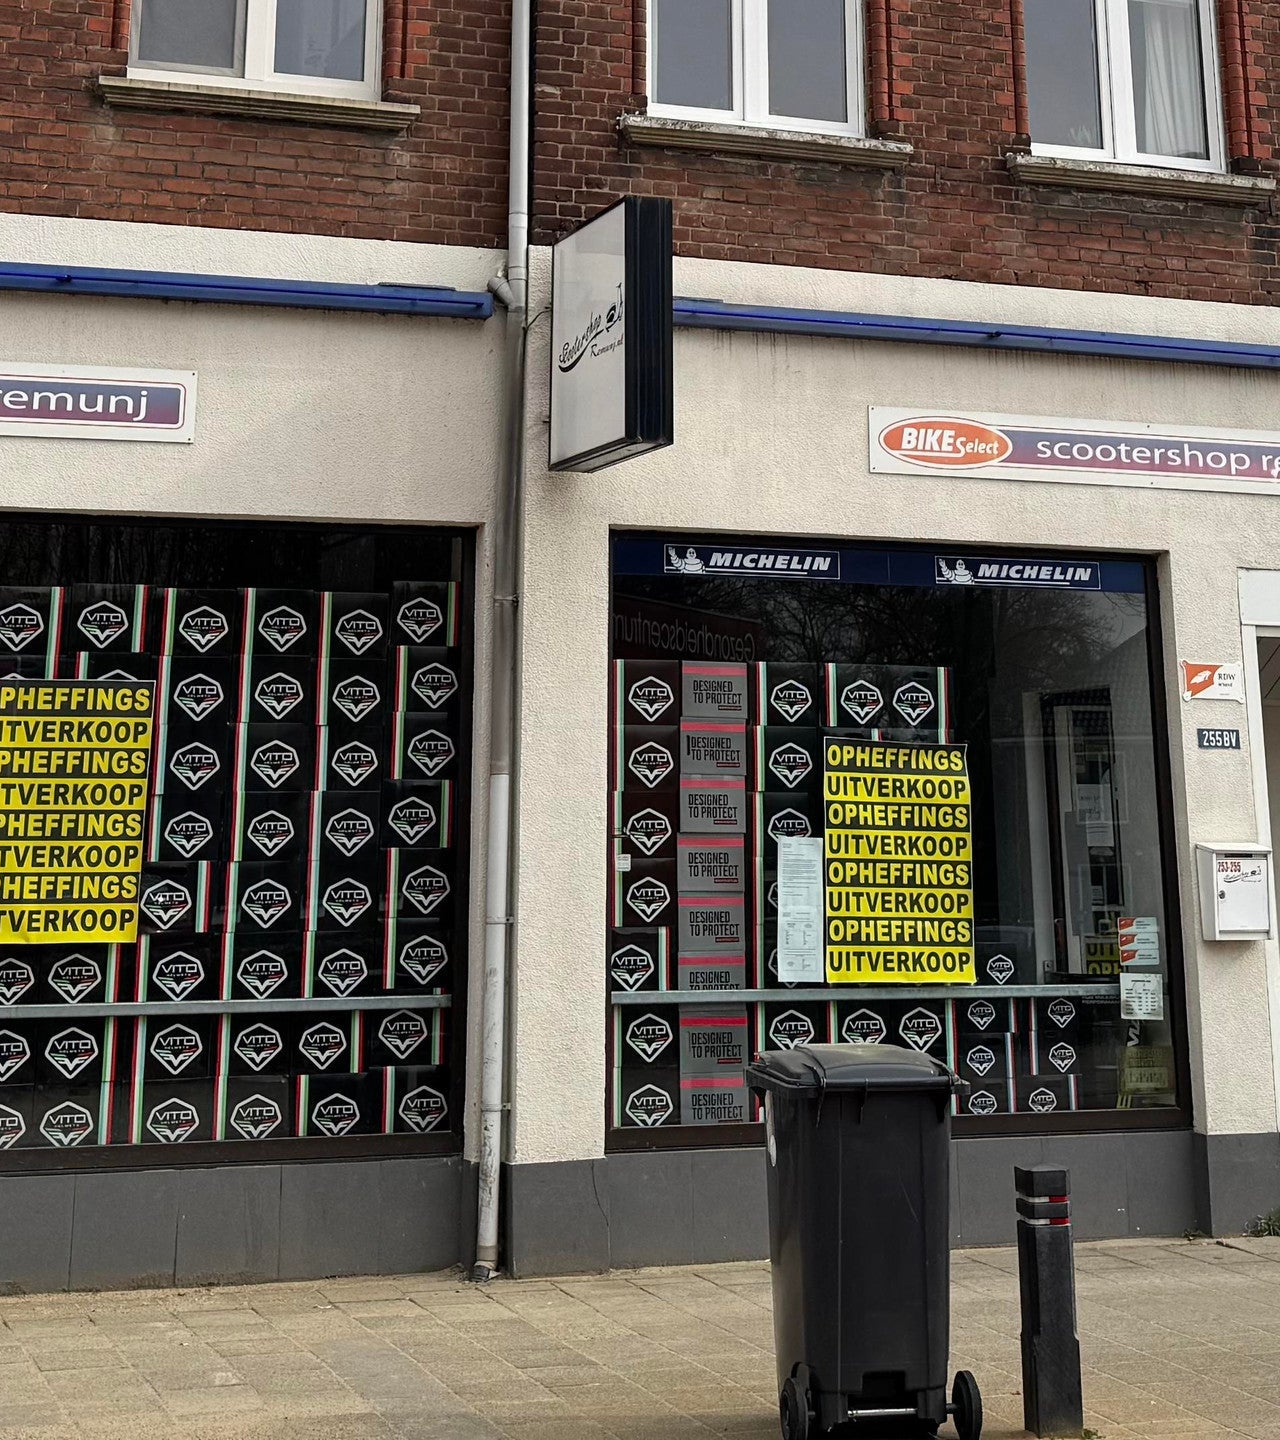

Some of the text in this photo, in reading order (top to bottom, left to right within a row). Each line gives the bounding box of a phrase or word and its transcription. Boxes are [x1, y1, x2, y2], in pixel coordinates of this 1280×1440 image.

[901, 428, 955, 452] BIKE
[955, 437, 999, 457] Select
[1037, 441, 1250, 474] scootershop
[709, 552, 831, 571] MICHELIN
[978, 564, 1091, 581] MICHELIN
[87, 612, 121, 621] VITO
[404, 609, 436, 617] VITO
[2, 615, 36, 624] VITO
[187, 617, 220, 626] VITO
[266, 617, 299, 626] VITO
[343, 621, 375, 629] VITO
[419, 674, 451, 682] VITO
[182, 685, 216, 694] VITO
[262, 684, 295, 693] VITO
[693, 680, 733, 692] DESIGNED
[340, 687, 373, 696] VITO
[635, 688, 667, 696] VITO
[693, 692, 742, 704] TO PROTECT
[415, 741, 448, 750] VITO
[691, 737, 731, 749] DESIGNED
[179, 753, 213, 762] VITO
[259, 752, 292, 761] VITO
[339, 752, 371, 760] VITO
[635, 753, 667, 761] VITO
[691, 749, 740, 761] TO PROTECT
[775, 754, 807, 762] VITO
[827, 745, 963, 771] OPHEFFINGS
[827, 776, 966, 799] UITVERKOOP
[688, 794, 728, 806] DESIGNED
[396, 808, 429, 817] VITO
[688, 807, 738, 818] TO PROTECT
[828, 803, 968, 828] OPHEFFINGS
[172, 822, 205, 831] VITO
[255, 822, 287, 830] VITO
[333, 820, 366, 829] VITO
[633, 820, 665, 828] VITO
[774, 820, 806, 828] VITO
[828, 834, 968, 856] UITVERKOOP
[688, 852, 729, 864] DESIGNED
[688, 865, 739, 877] TO PROTECT
[829, 862, 969, 886] OPHEFFINGS
[410, 877, 443, 886] VITO
[250, 891, 284, 900] VITO
[330, 890, 363, 899] VITO
[633, 888, 665, 896] VITO
[829, 892, 969, 913] UITVERKOOP
[689, 911, 730, 923] DESIGNED
[690, 924, 739, 936] TO PROTECT
[829, 920, 971, 942] OPHEFFINGS
[408, 947, 442, 956] VITO
[614, 956, 647, 965] VITO
[830, 951, 971, 973] UITVERKOOP
[58, 965, 94, 975] VITO
[161, 963, 197, 973] VITO
[246, 962, 280, 971] VITO
[326, 961, 359, 970] VITO
[689, 971, 730, 983] DESIGNED
[386, 1021, 420, 1030] VITO
[776, 1022, 808, 1030] VITO
[848, 1020, 880, 1028] VITO
[633, 1026, 666, 1035] VITO
[160, 1036, 194, 1045] VITO
[242, 1035, 275, 1044] VITO
[306, 1034, 339, 1043] VITO
[691, 1032, 732, 1044] DESIGNED
[54, 1039, 90, 1049] VITO
[692, 1044, 742, 1058] TO PROTECT
[407, 1098, 441, 1107] VITO
[633, 1096, 666, 1105] VITO
[692, 1093, 733, 1106] DESIGNED
[239, 1106, 275, 1116] VITO
[320, 1105, 353, 1114] VITO
[692, 1106, 743, 1120] TO PROTECT
[49, 1113, 85, 1123] VITO
[156, 1110, 192, 1120] VITO
